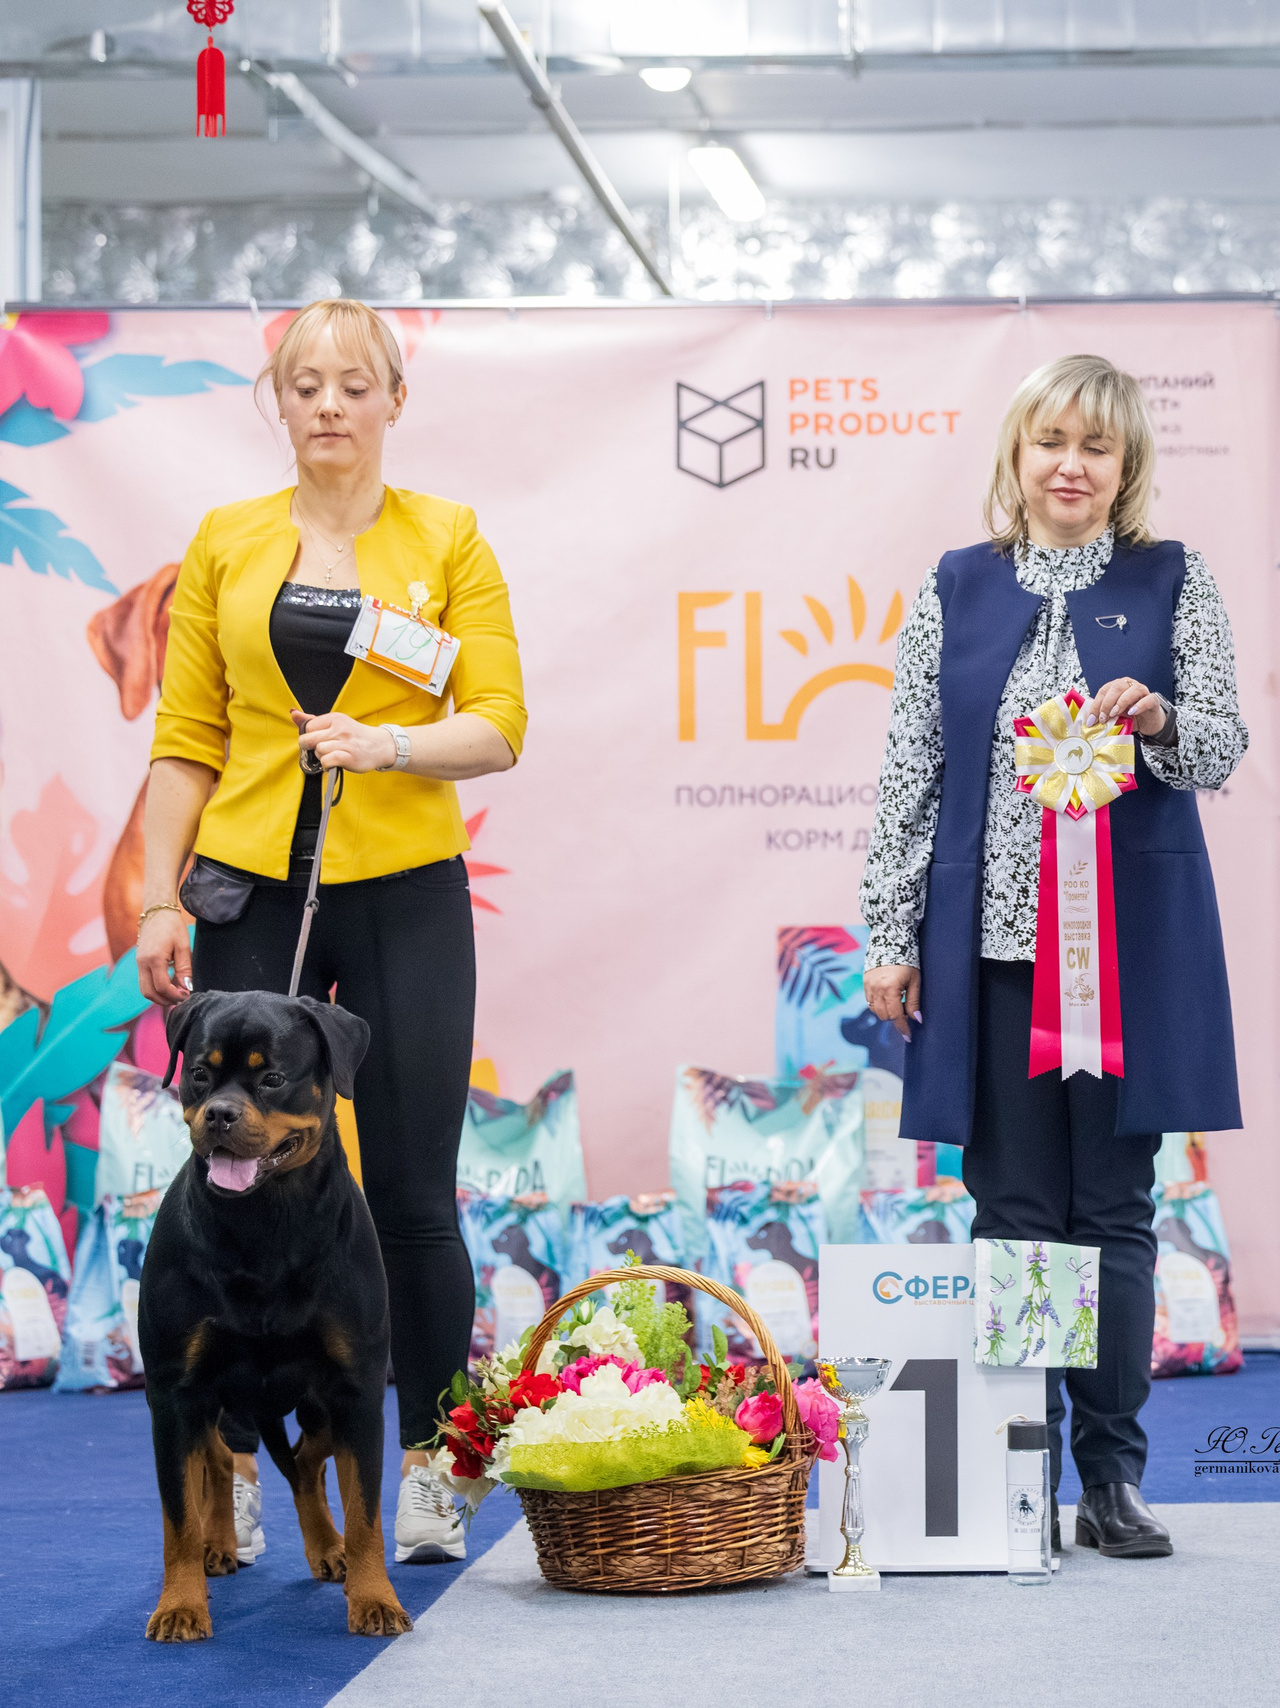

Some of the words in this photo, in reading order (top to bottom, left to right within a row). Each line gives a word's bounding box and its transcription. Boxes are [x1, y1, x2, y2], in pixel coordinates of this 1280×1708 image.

[789, 378, 878, 401] PETS
[789, 411, 961, 435] PRODUCT
[790, 447, 836, 469] RU
[675, 784, 878, 807] ПОЛНОРАЦИО
[765, 829, 843, 850] КОРМ
[1066, 947, 1090, 969] CW
[889, 1359, 958, 1537] 1
